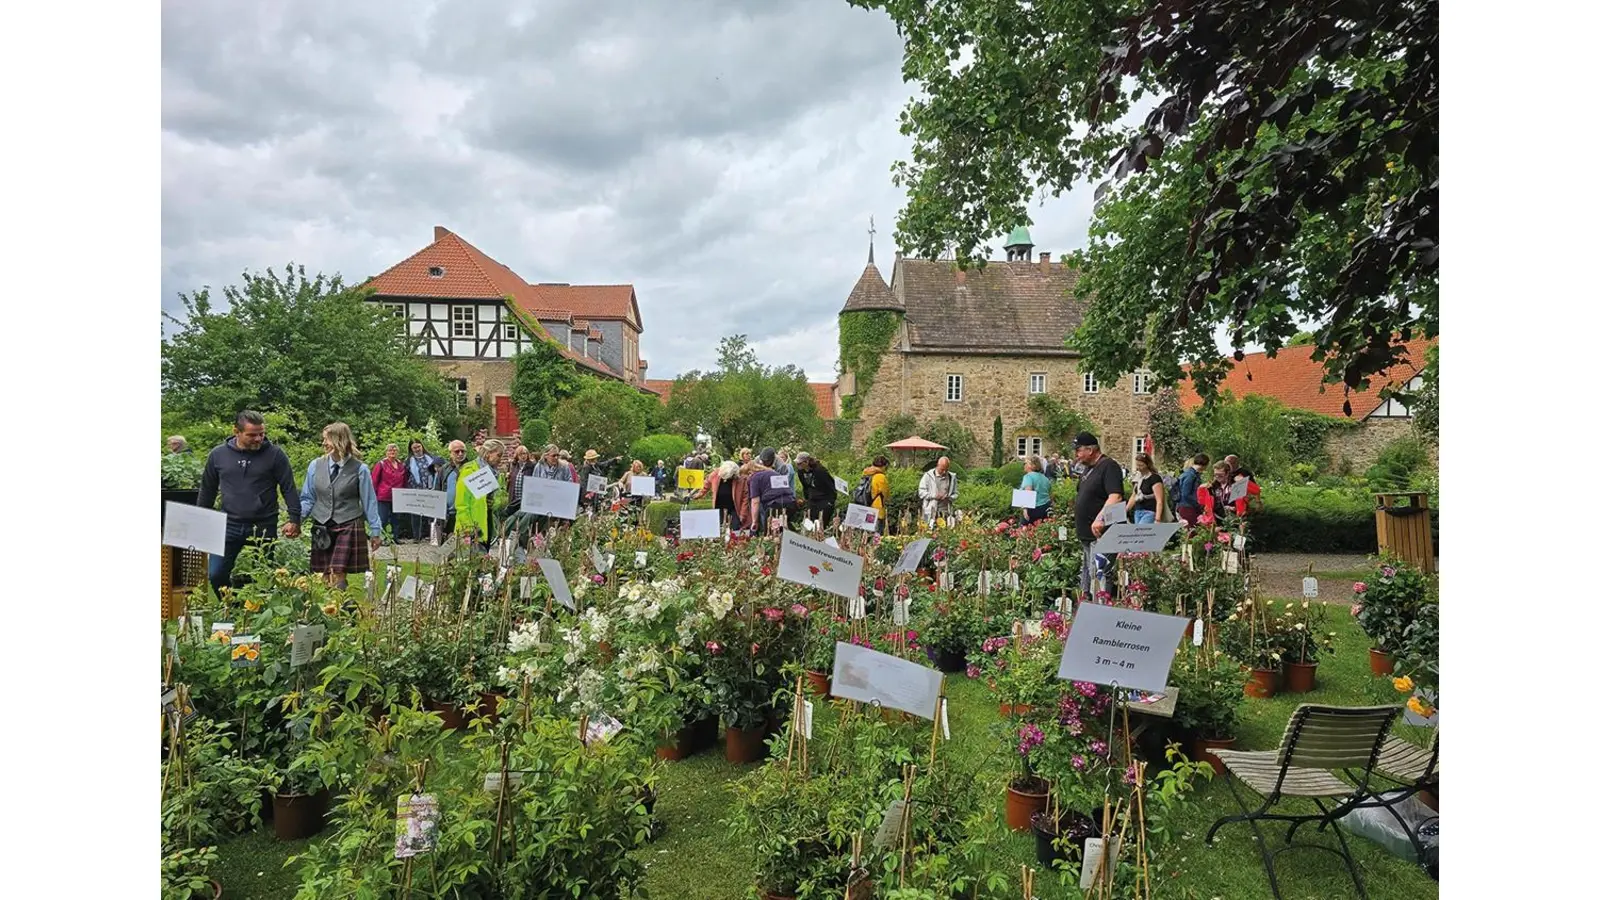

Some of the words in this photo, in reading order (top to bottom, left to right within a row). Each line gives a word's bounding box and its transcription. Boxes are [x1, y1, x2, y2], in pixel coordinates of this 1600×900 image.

[1115, 620, 1142, 631] Kleine
[1092, 636, 1150, 652] Ramblerrosen
[1095, 655, 1101, 664] 3
[1102, 658, 1111, 666] m
[1119, 660, 1125, 668] 4
